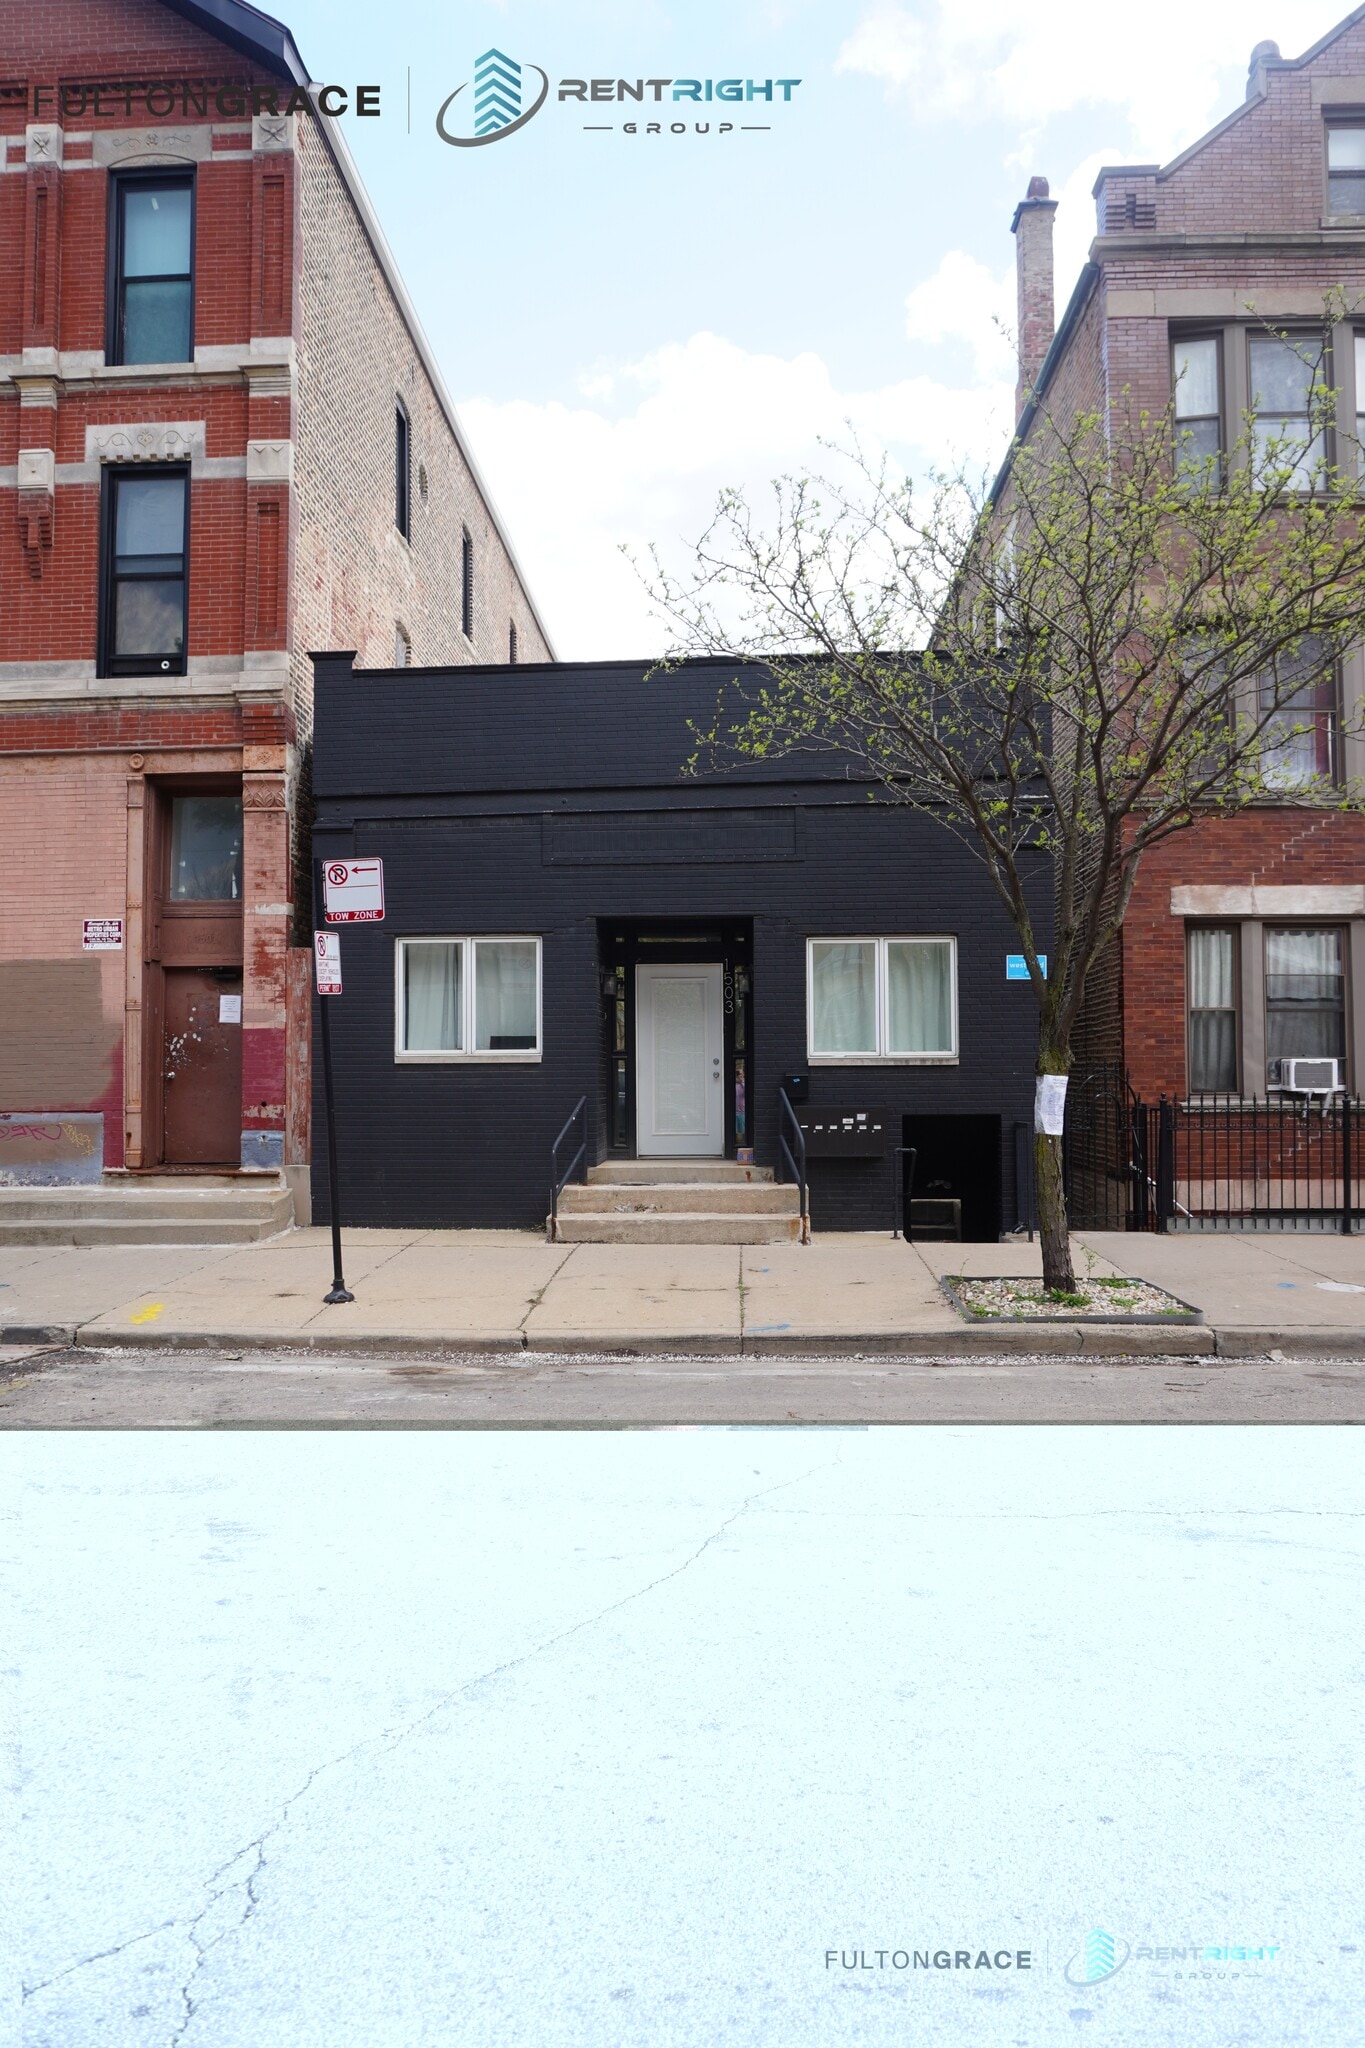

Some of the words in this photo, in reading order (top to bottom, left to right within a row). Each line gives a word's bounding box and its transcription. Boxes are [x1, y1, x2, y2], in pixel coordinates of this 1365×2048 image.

[329, 912, 350, 921] TOW
[353, 910, 379, 920] ZONE
[724, 958, 734, 1014] 1503
